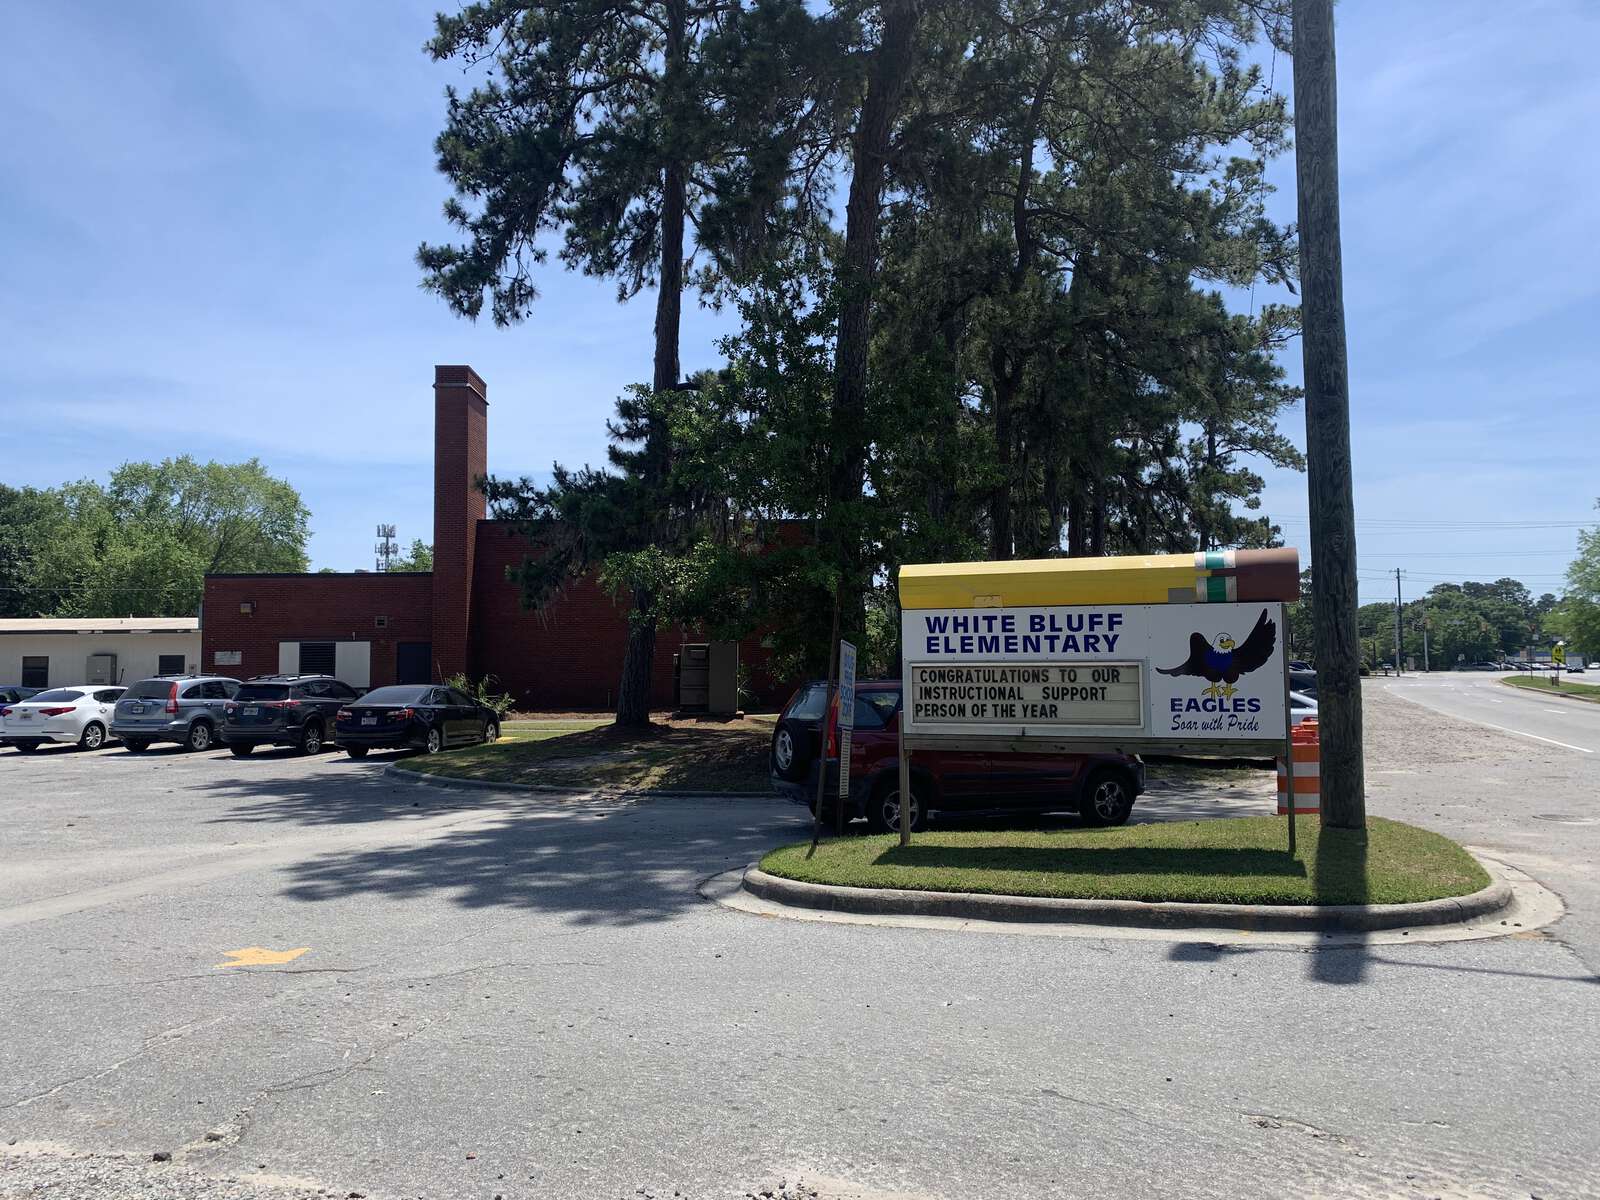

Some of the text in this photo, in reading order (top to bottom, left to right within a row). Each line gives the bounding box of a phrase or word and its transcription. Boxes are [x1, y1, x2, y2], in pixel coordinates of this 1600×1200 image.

[925, 613, 1123, 634] WHITE BLUFF
[926, 634, 1120, 654] ELEMENTARY
[920, 669, 1121, 683] CONGRATULATIONS TO OUR
[919, 686, 1107, 701] INSTRUCTIONAL SUPPORT
[915, 703, 1058, 718] PERSON OF THE YEAR
[1170, 698, 1261, 713] EAGLES
[1171, 714, 1259, 731] Soar with Pride
